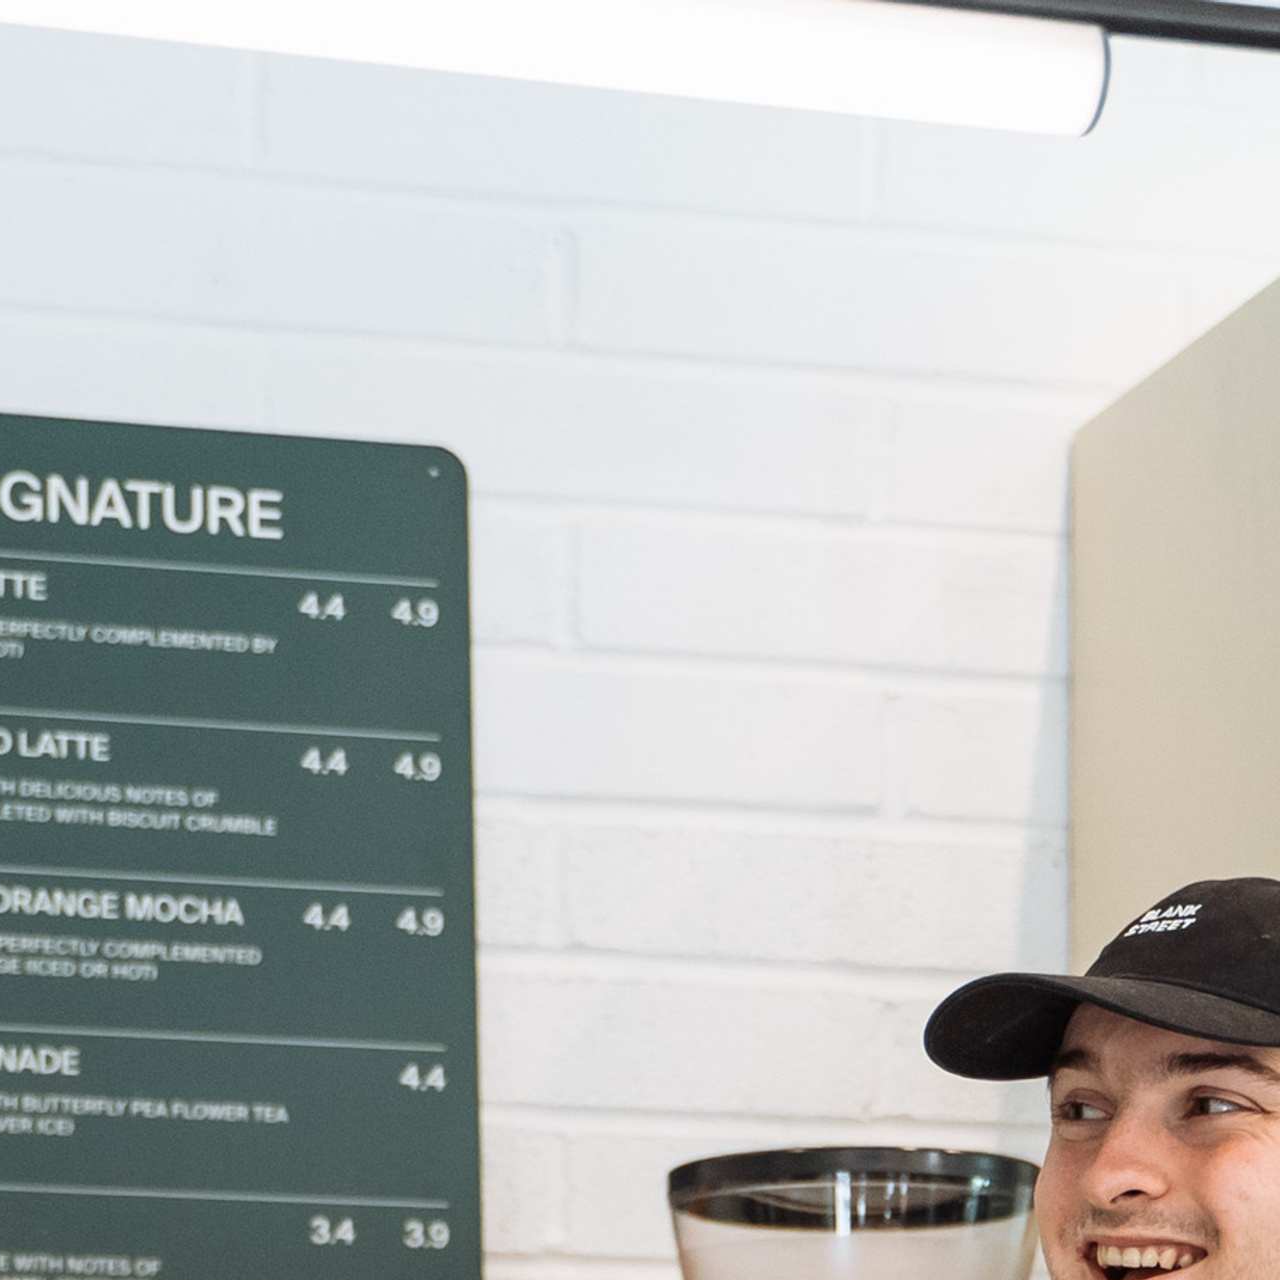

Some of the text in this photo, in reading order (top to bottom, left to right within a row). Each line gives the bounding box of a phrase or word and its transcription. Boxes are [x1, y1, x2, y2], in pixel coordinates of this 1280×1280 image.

[298, 590, 346, 620] 4.4
[390, 598, 440, 627] 4.9
[89, 623, 250, 652] COMPLEMENTED
[251, 633, 279, 654] BY
[18, 728, 111, 762] LATTE
[300, 746, 349, 775] 4.4
[393, 752, 442, 782] 4.9
[20, 779, 121, 803] DELICIOUS
[123, 783, 188, 806] NOTES
[192, 787, 218, 807] OF
[53, 803, 104, 825] WITH
[106, 806, 181, 829] BISCUIT
[184, 812, 277, 836] CRUMBLE
[124, 891, 244, 926] MOCHA
[303, 902, 352, 932] 4.4
[396, 906, 444, 937] 4.9
[1123, 918, 1197, 937] STREET
[1139, 904, 1202, 923] BLANK
[103, 938, 263, 966] COMPLEMENTED
[78, 960, 109, 978] OR
[398, 1062, 447, 1092] 4.4
[21, 1092, 128, 1117] BUTTERFLY
[129, 1097, 169, 1118] PEA
[170, 1099, 250, 1122] FLOWER
[251, 1102, 291, 1123] TEA
[309, 1214, 356, 1245] 3.4
[403, 1218, 450, 1249] 3.9
[12, 1252, 65, 1273] WITH
[67, 1254, 132, 1276] NOTES
[134, 1256, 161, 1276] OF
